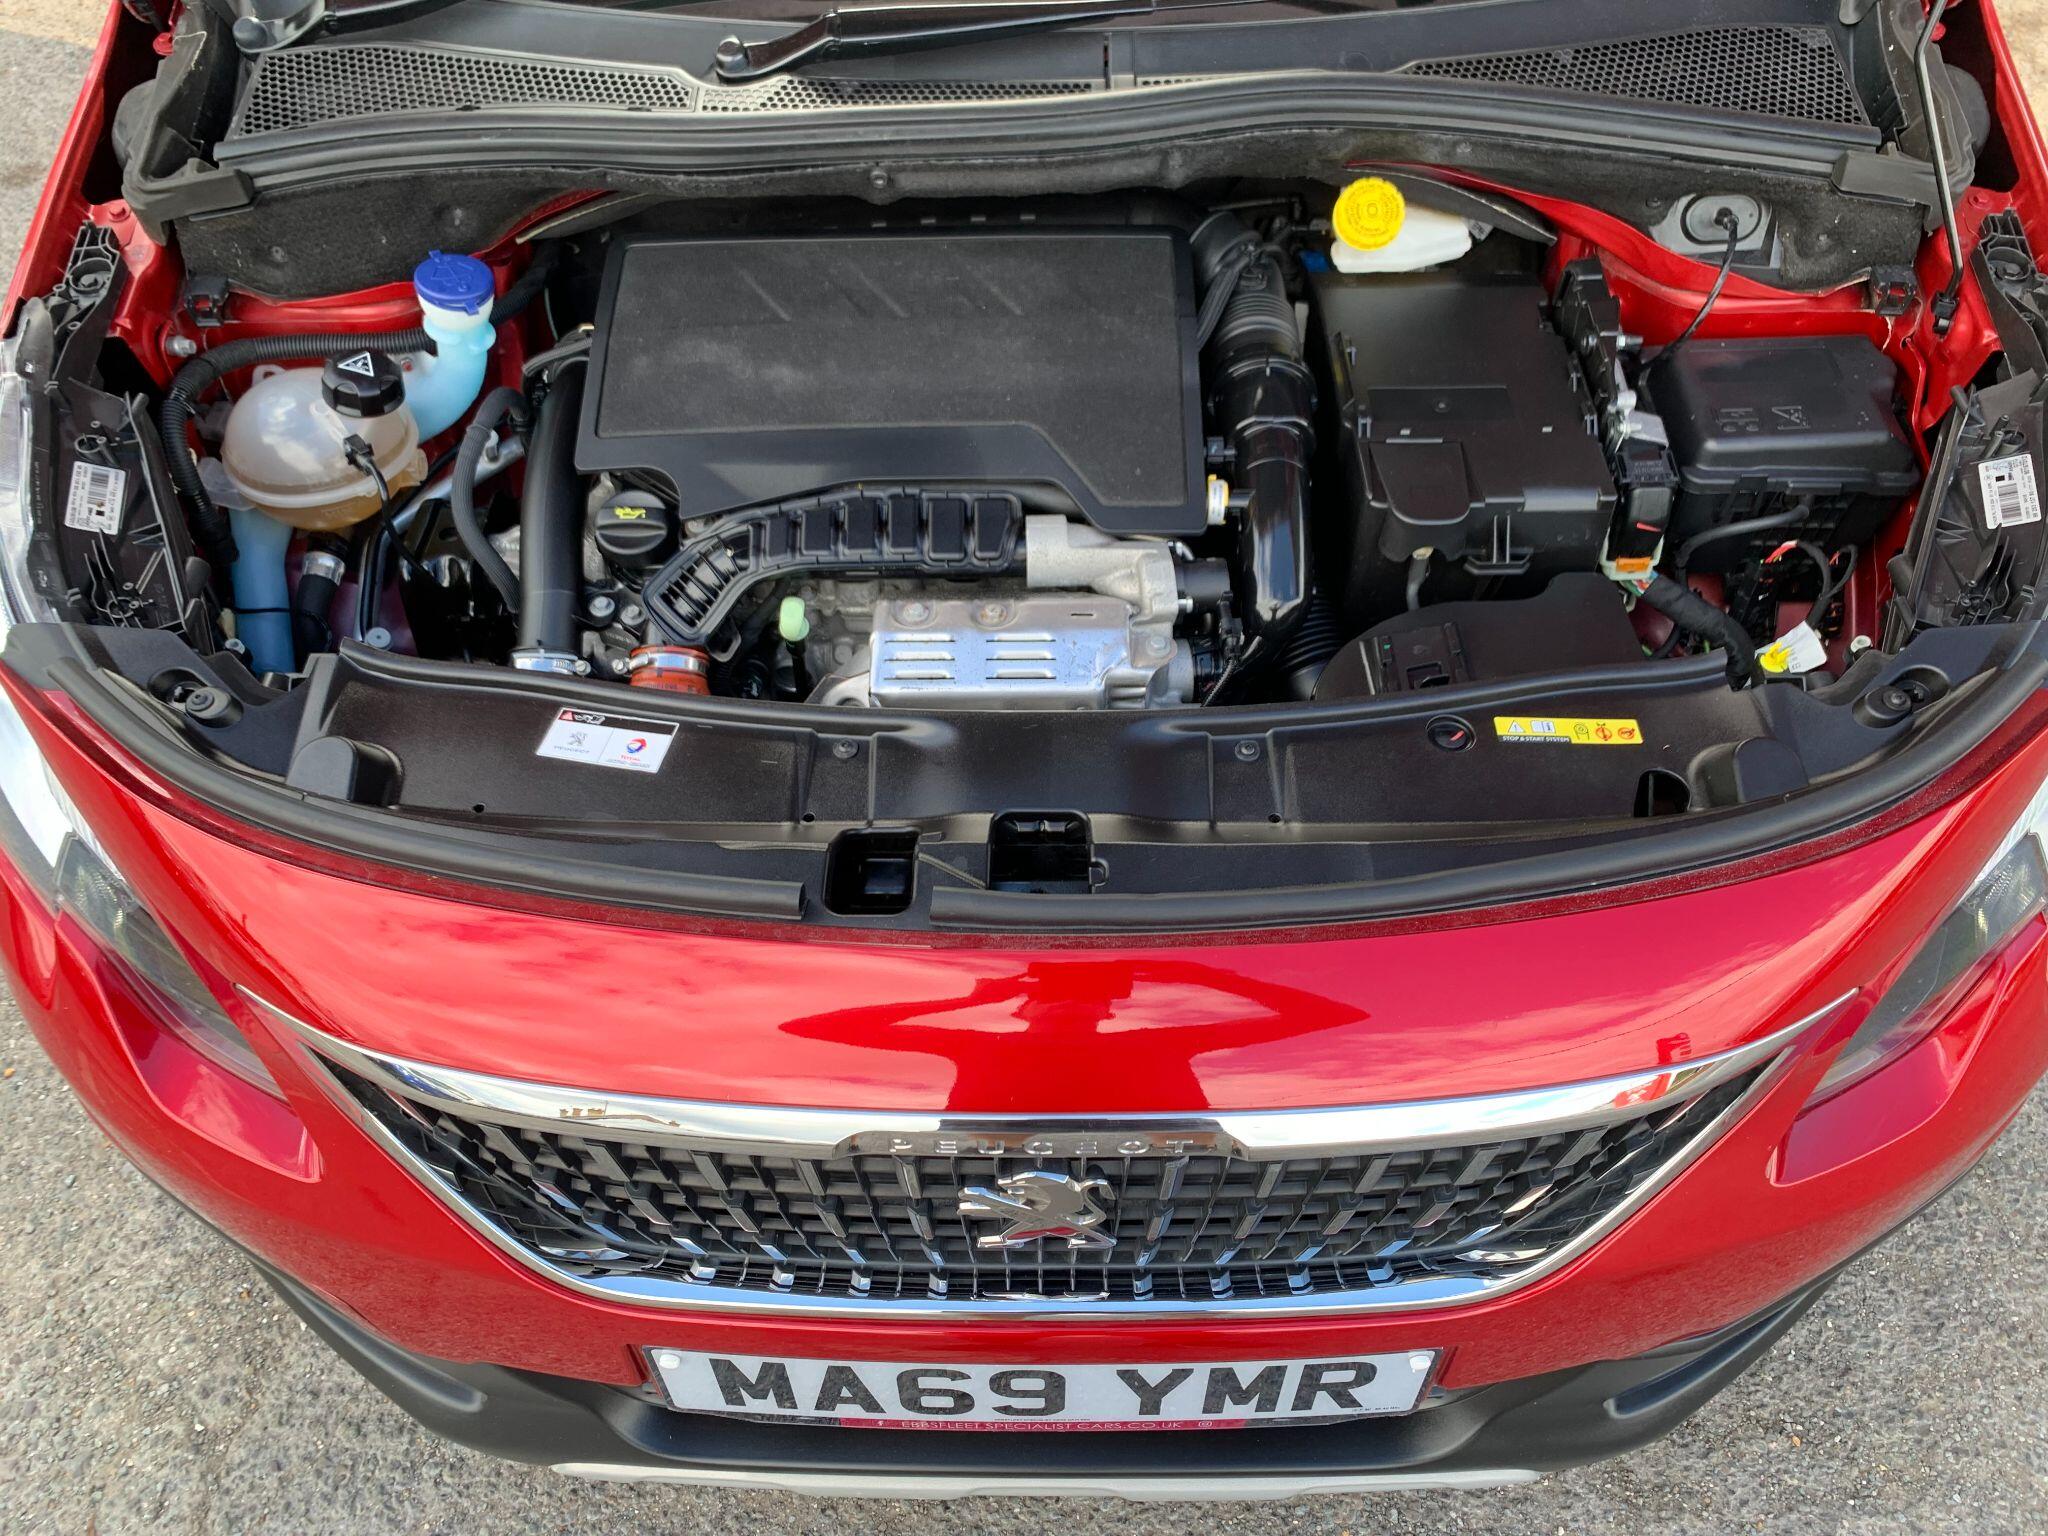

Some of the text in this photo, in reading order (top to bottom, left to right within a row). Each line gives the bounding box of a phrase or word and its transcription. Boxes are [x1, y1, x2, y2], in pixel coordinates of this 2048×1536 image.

[889, 1138, 1195, 1155] PEUGEOT
[709, 1358, 1378, 1416] MA69 YMR
[901, 1421, 1183, 1430] EBBSFLEET SPECIALIST CARS.CO.UK
